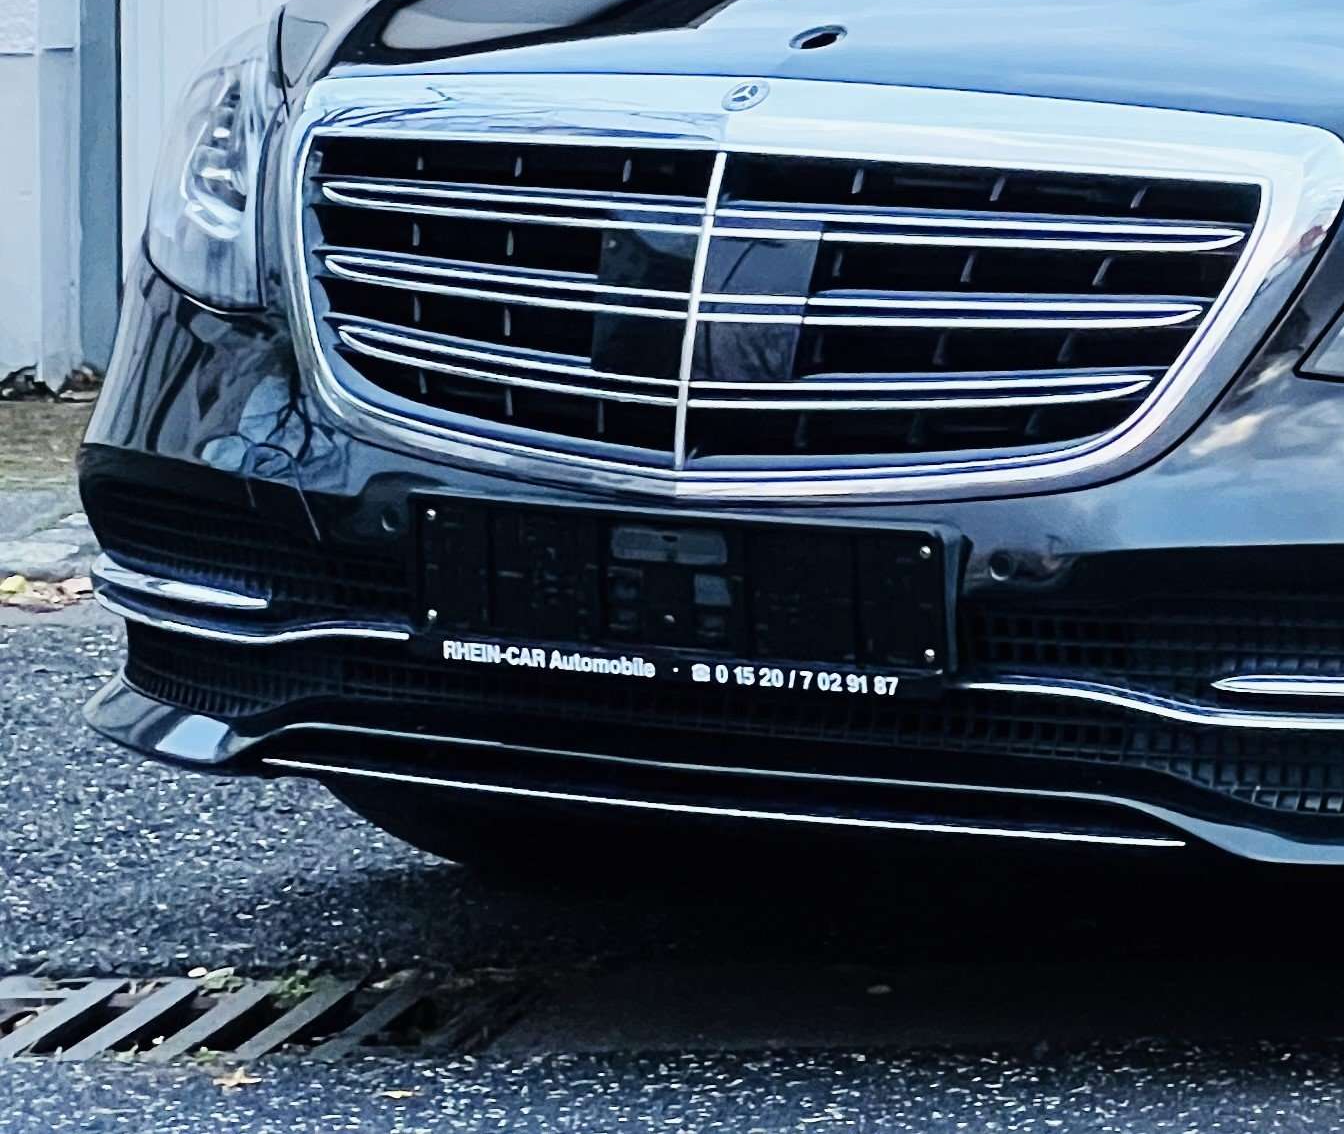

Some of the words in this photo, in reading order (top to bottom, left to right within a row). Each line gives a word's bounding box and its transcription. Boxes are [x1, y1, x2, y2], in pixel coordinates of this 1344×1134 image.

[443, 641, 545, 668] RHEIN-CAR
[549, 650, 655, 677] Automobile
[733, 666, 755, 685] 15
[759, 668, 784, 687] 20
[817, 672, 842, 691] 02
[846, 674, 868, 693] 91
[874, 676, 898, 695] 87
